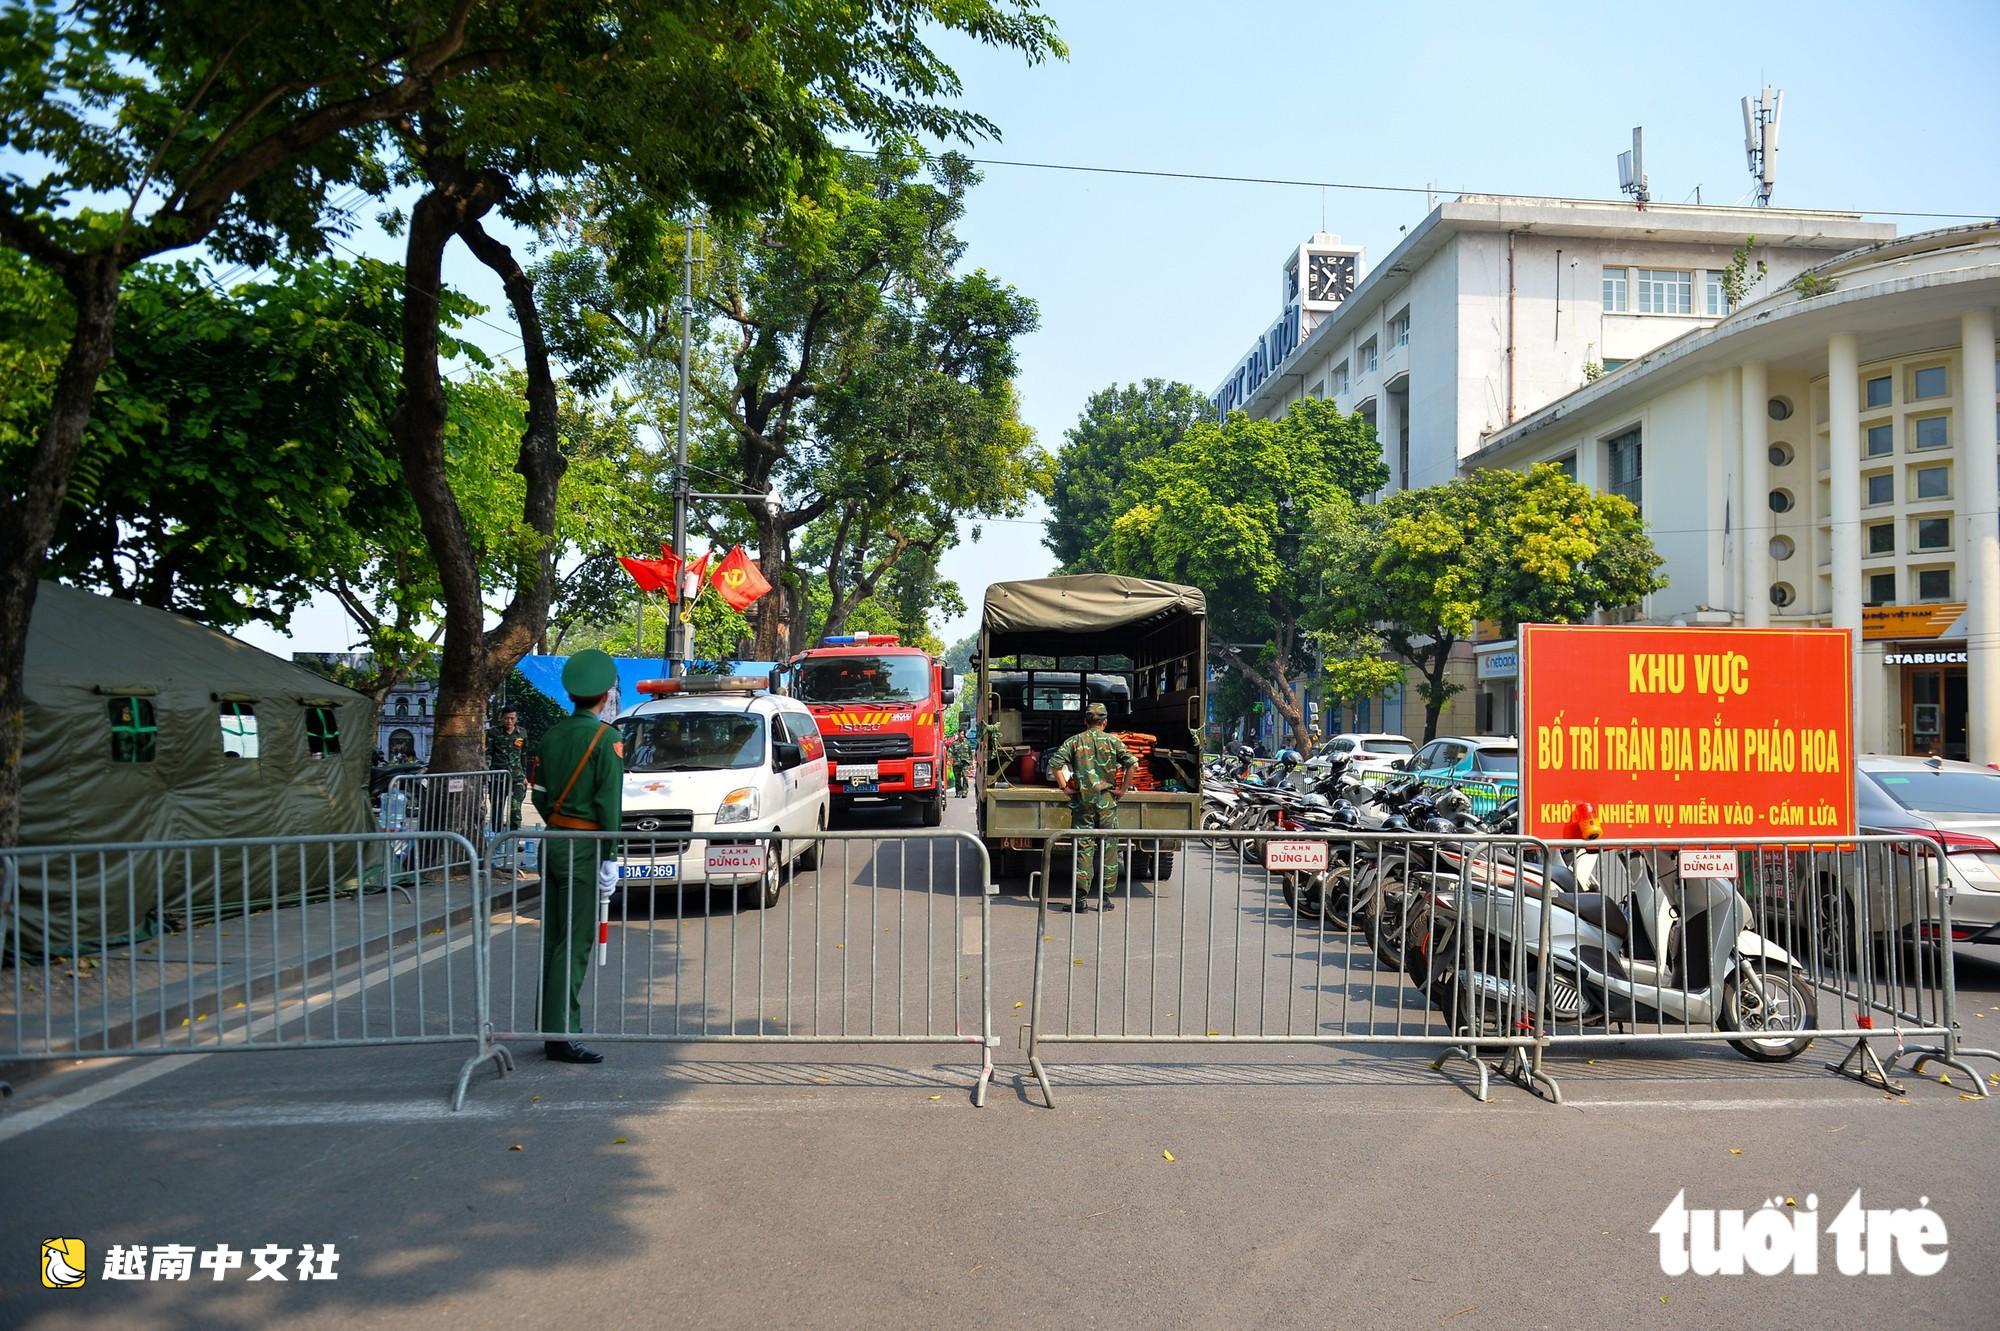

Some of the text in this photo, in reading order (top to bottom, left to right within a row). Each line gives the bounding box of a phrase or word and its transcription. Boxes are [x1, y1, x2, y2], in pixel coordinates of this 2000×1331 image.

[1345, 275, 1354, 284] 3
[1327, 292, 1336, 301] 6
[1270, 305, 1299, 371] NỘI
[1629, 651, 1749, 702] KHU VỰC
[1538, 710, 1840, 781] BỐ TRÍ TRẬN ĐỊA BẮN PHÁO HOA
[1540, 800, 1579, 823] KHÔ
[1598, 800, 1650, 828] NHIỆM
[1654, 804, 1674, 828] VỤ
[1679, 798, 1720, 825] MIỄN
[1724, 802, 1754, 825] VÀO
[1769, 800, 1804, 826] CẤM
[1809, 799, 1838, 826] LỬA
[709, 856, 761, 868] DỪNG LẠI
[1271, 851, 1323, 865] DỪNG LẠI
[1684, 860, 1733, 873] DỪNG LẠI
